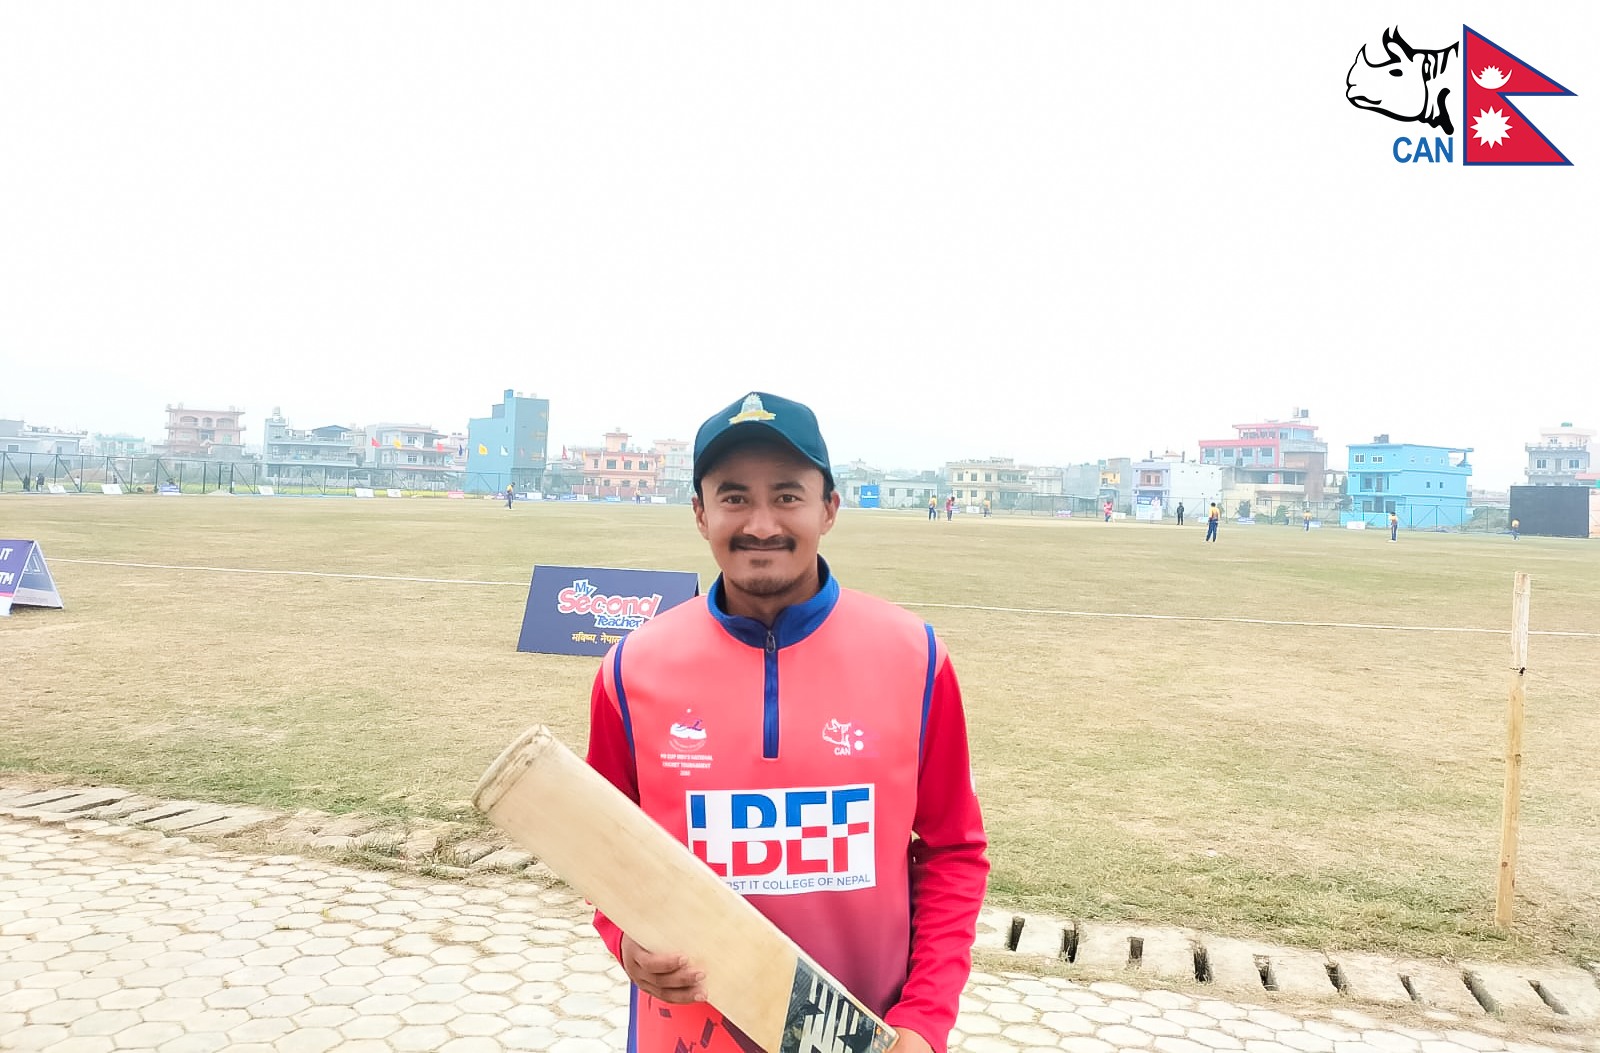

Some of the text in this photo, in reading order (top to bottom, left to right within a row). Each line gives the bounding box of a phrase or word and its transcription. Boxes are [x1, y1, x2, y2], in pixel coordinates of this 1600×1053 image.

[574, 580, 595, 596] My
[558, 588, 661, 618] Second
[595, 614, 643, 629] Teacher
[834, 746, 851, 756] CAN
[690, 787, 870, 878] LBEF
[749, 880, 760, 890] IT
[762, 877, 815, 891] COLLEGE
[817, 876, 834, 887] OF
[836, 873, 871, 887] NEPAL
